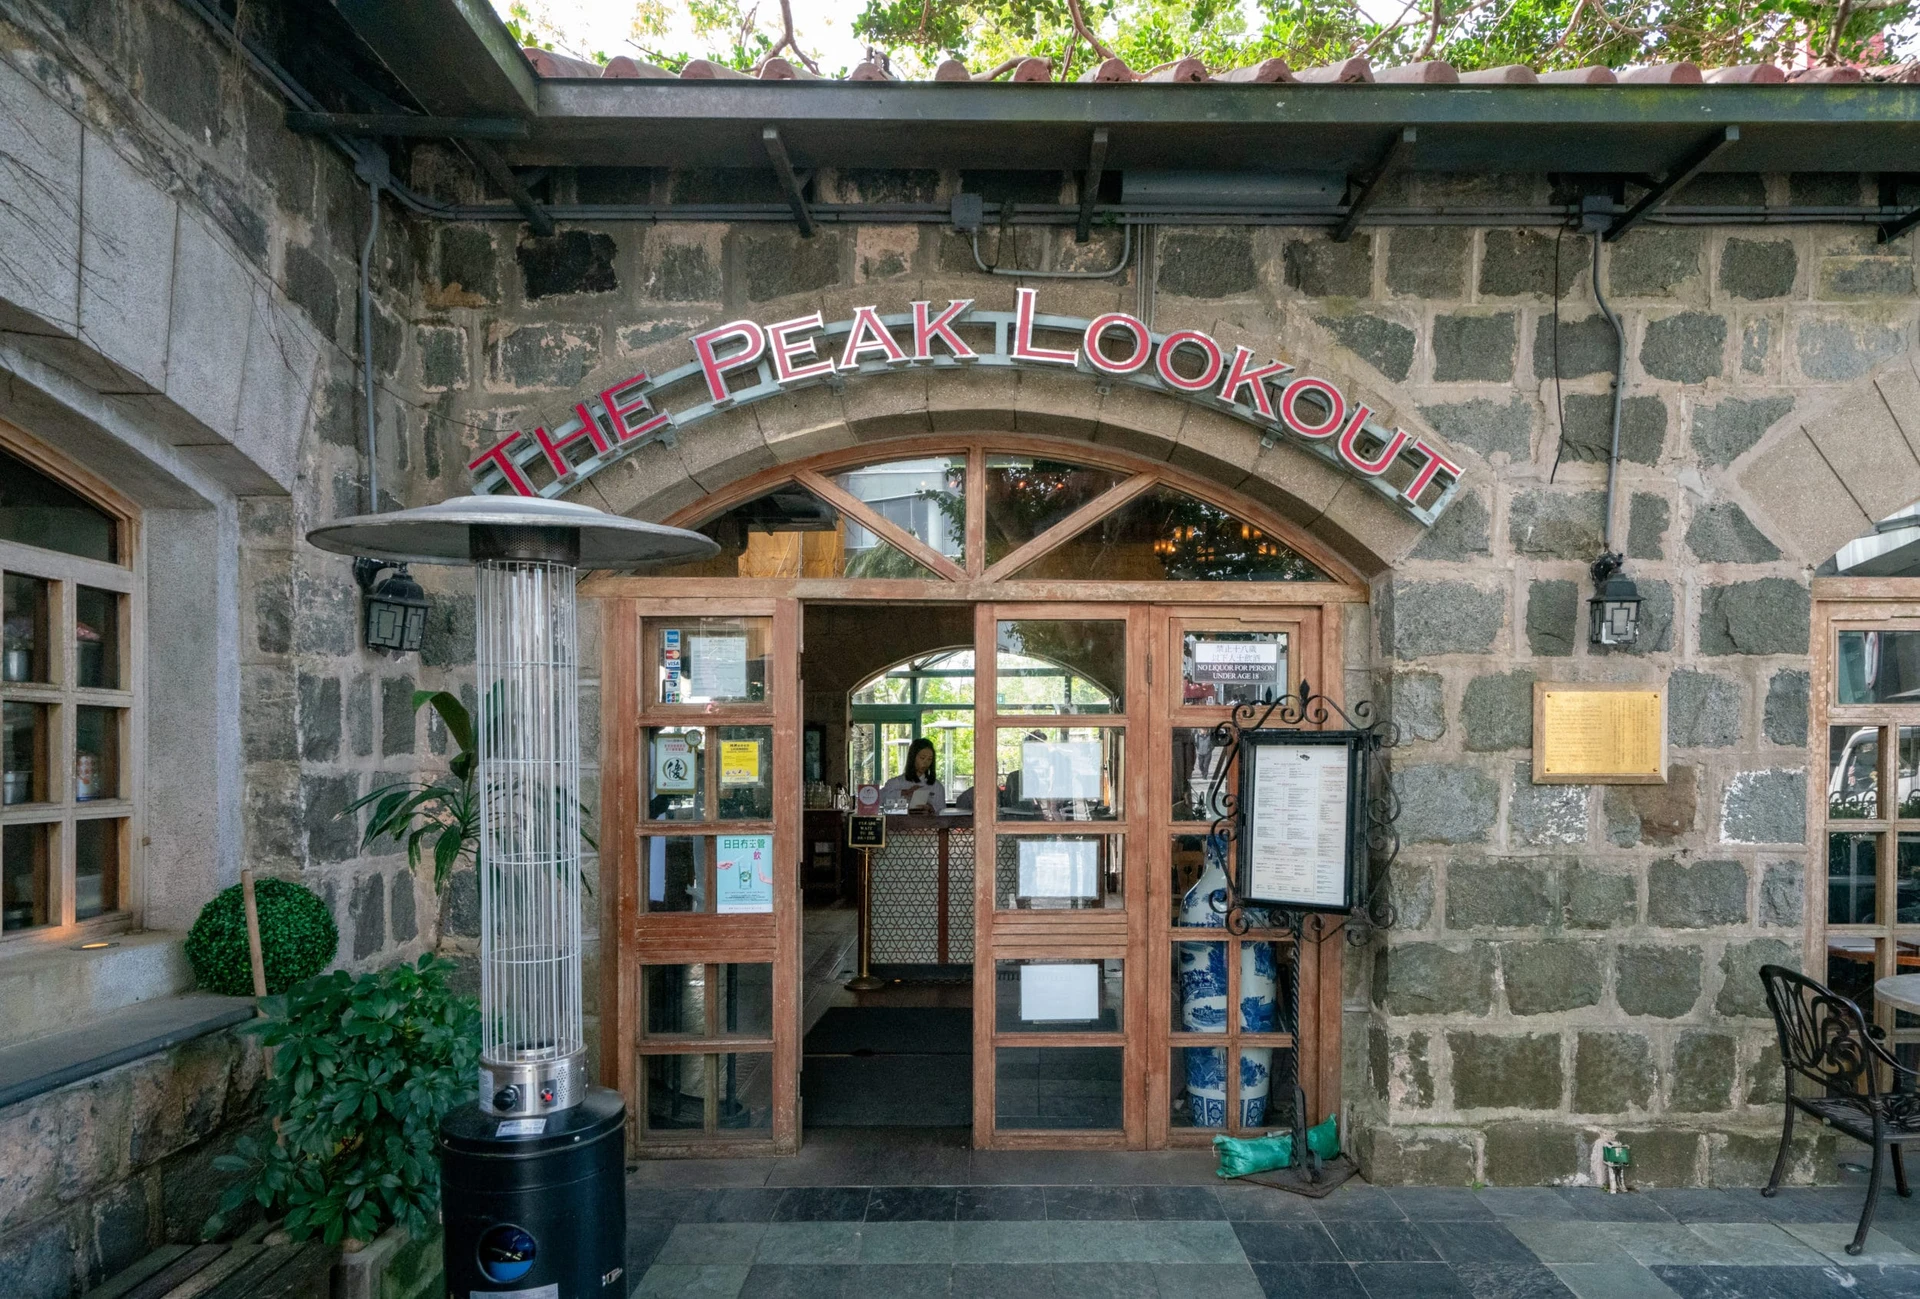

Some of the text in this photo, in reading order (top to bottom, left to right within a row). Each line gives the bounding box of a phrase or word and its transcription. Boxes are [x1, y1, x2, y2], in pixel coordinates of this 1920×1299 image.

[468, 287, 1467, 506] THE PEAK LOOKOUT
[1208, 664, 1234, 672] LIQUOR
